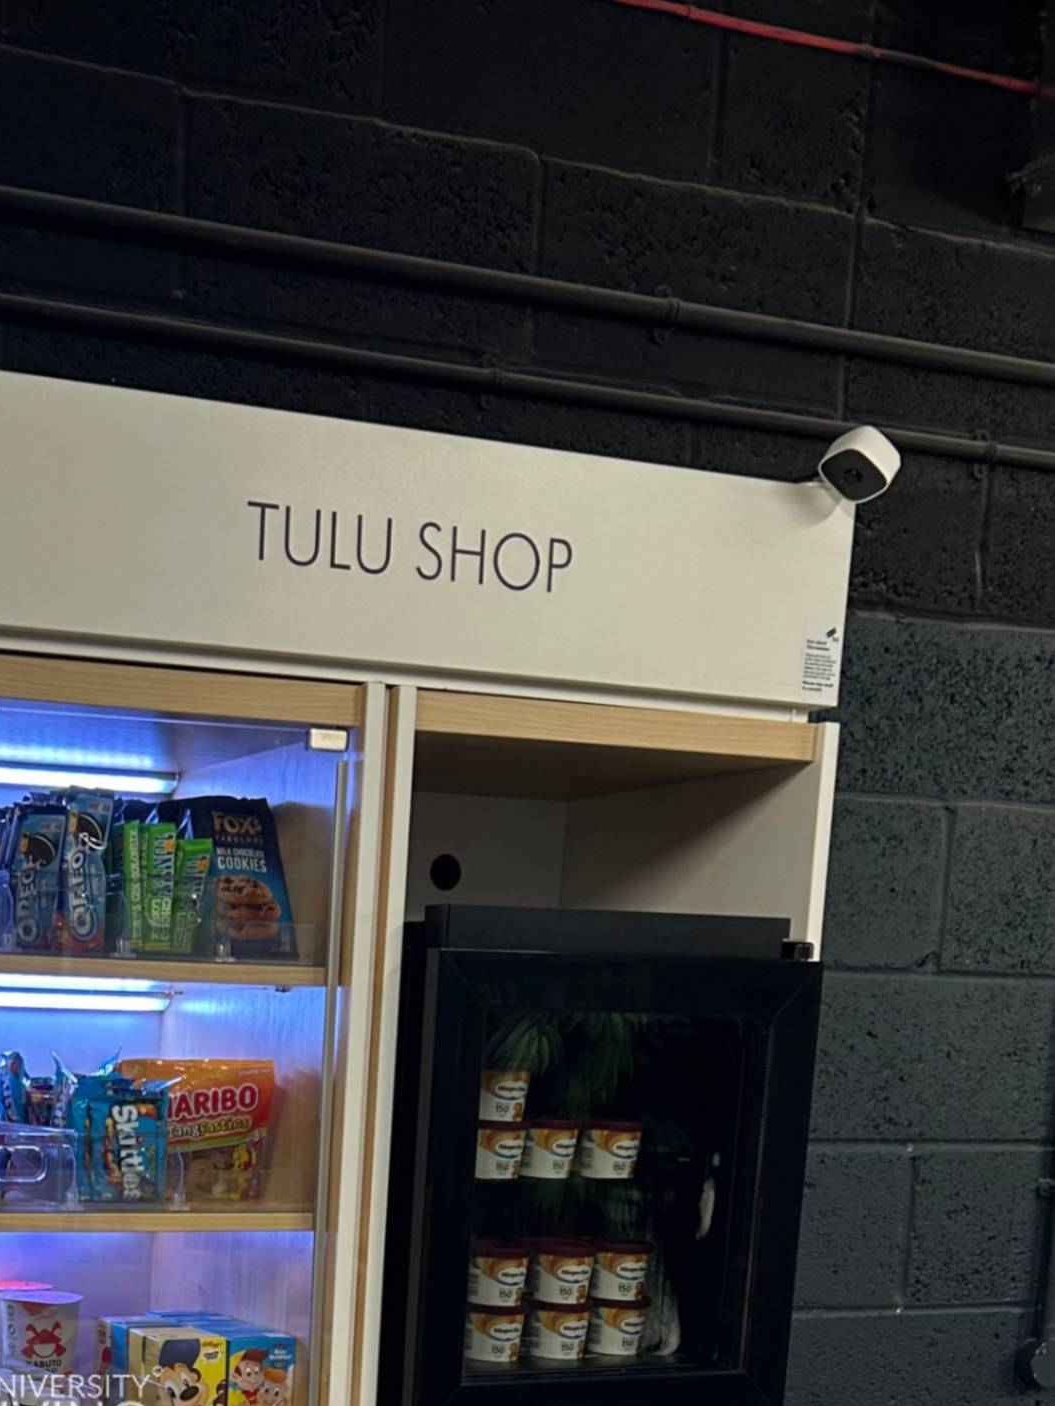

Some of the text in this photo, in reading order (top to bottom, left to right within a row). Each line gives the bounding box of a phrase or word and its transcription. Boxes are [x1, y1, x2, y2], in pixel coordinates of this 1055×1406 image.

[247, 500, 574, 593] TULU SHOP
[69, 850, 94, 939] OREO
[217, 856, 268, 874] COOKIES
